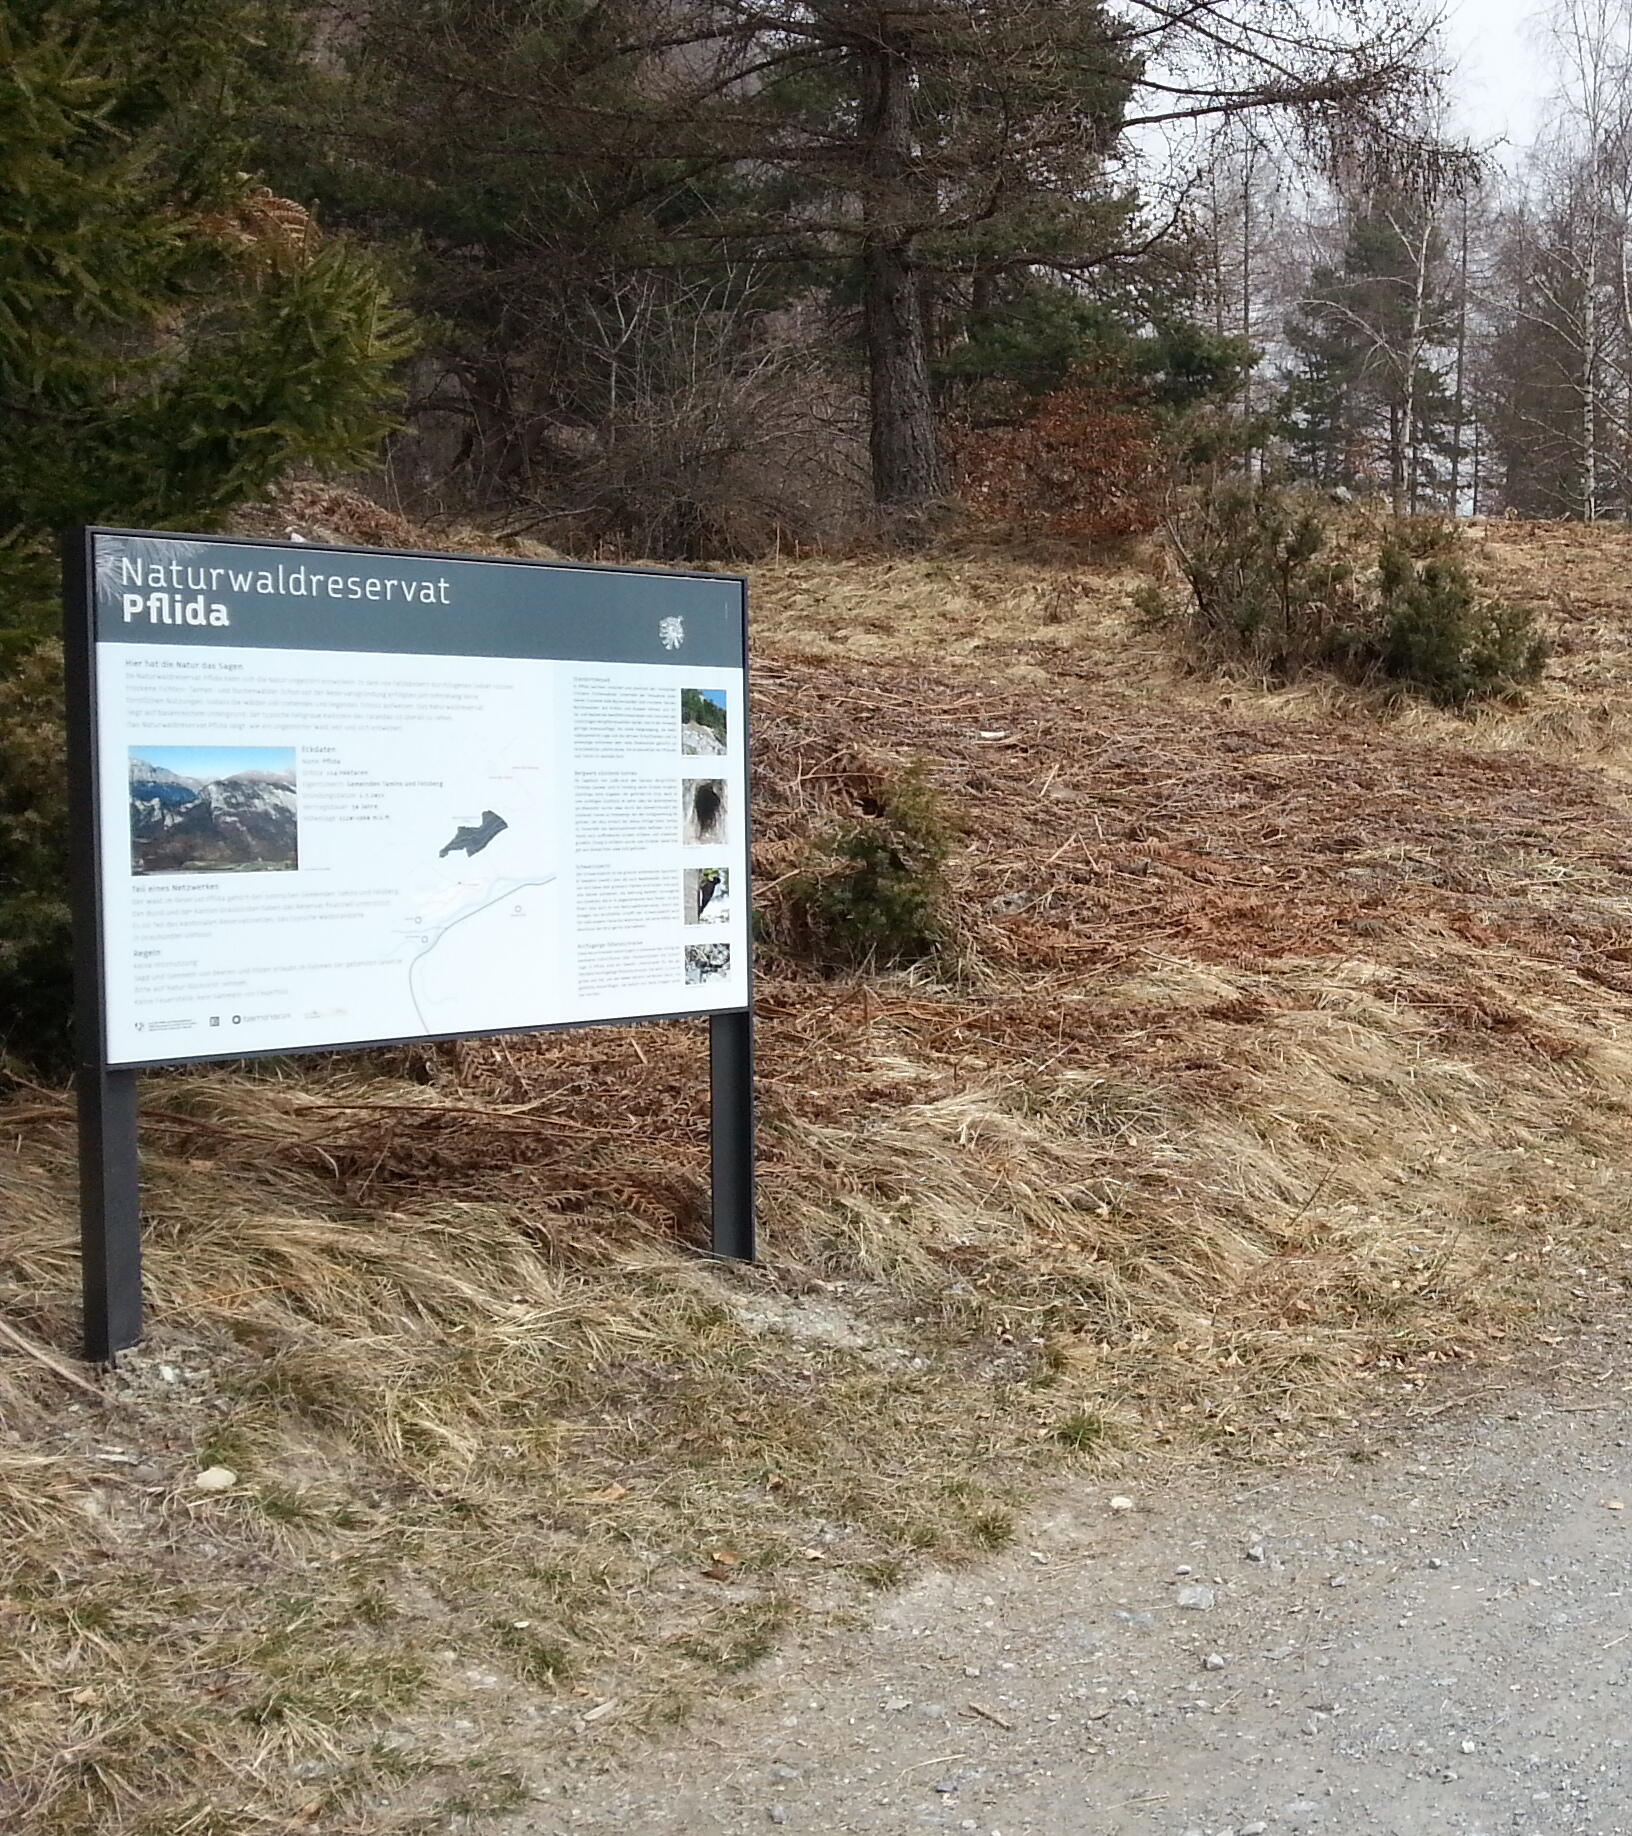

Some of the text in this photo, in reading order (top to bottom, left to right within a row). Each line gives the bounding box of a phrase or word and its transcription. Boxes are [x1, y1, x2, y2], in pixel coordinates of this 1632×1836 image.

[121, 557, 451, 604] Naturwaldreservat
[123, 592, 231, 627] Pflida
[145, 660, 159, 668] hat
[161, 661, 173, 669] die
[176, 661, 199, 669] Natur
[202, 662, 216, 670] das
[219, 662, 244, 672] Sagen
[132, 884, 146, 893] Teil
[149, 885, 170, 893] eines
